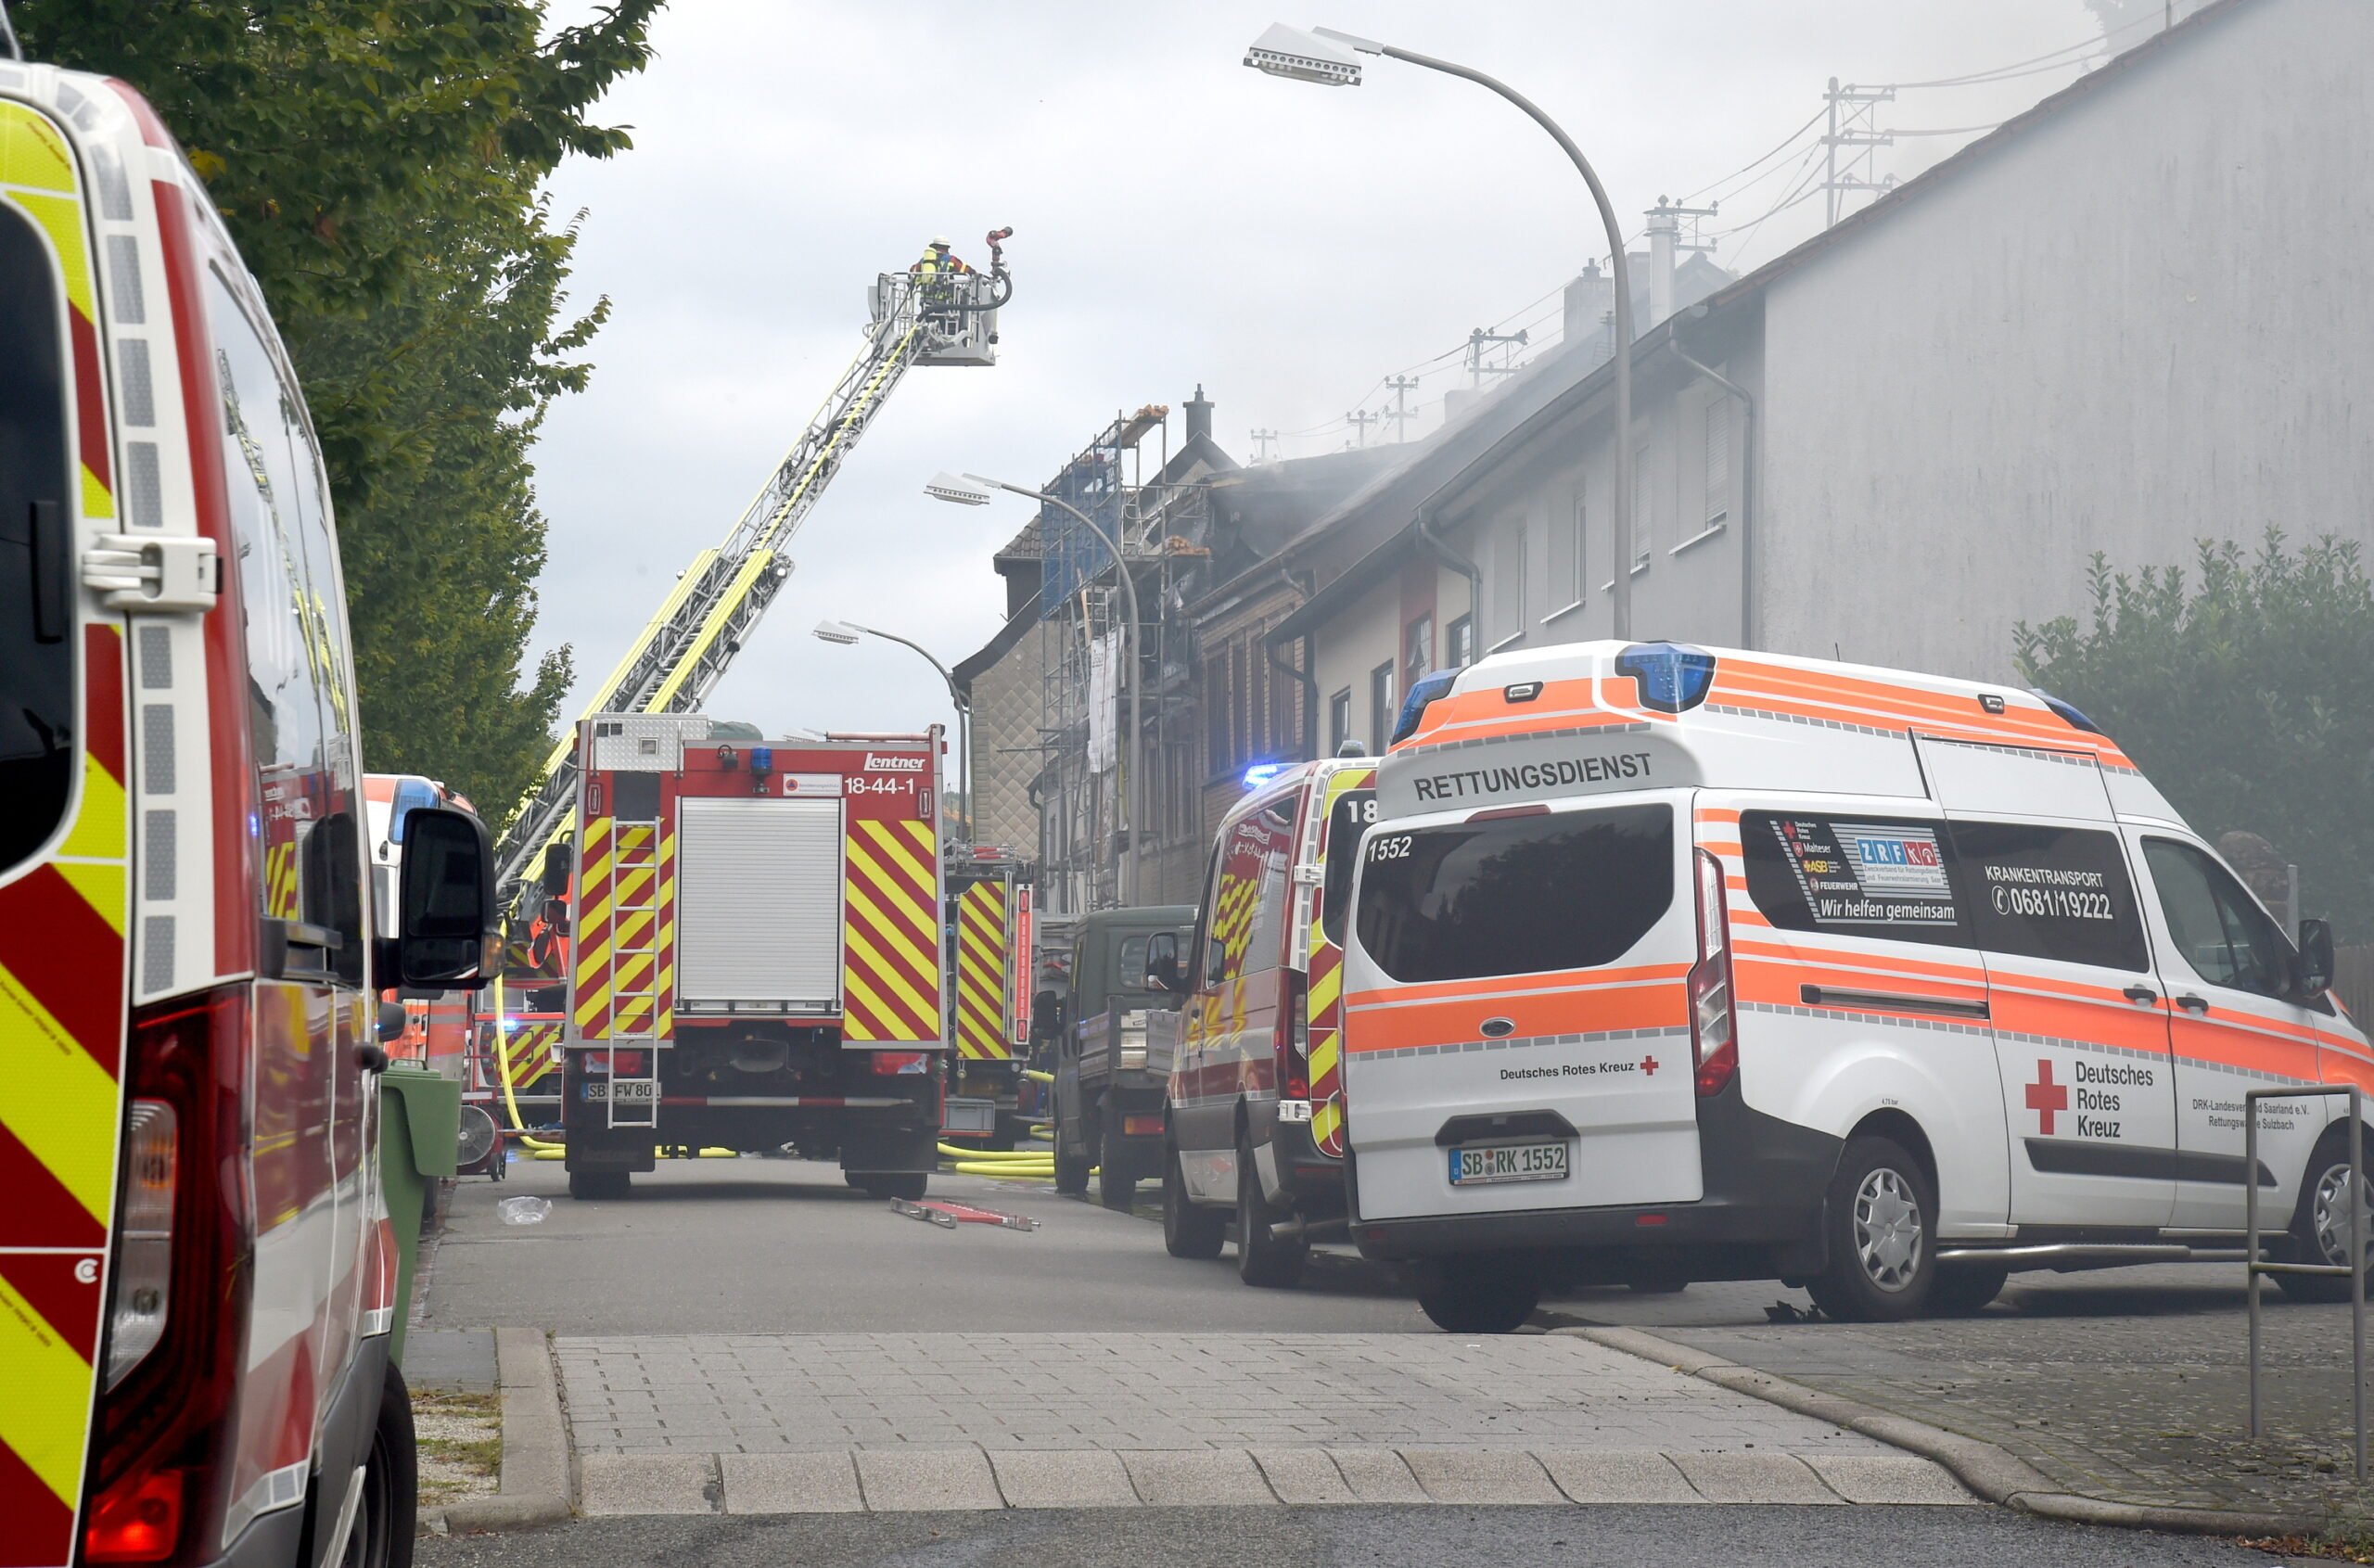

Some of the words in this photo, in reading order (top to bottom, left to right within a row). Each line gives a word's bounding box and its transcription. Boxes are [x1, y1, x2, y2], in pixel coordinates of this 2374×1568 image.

[864, 752, 925, 771] Lentner
[845, 777, 914, 795] 18-44-1
[1413, 753, 1651, 801] RETTUNGSDIENST
[1347, 799, 1378, 823] 18
[1369, 835, 1412, 863] 1552
[1803, 842, 1831, 853] Malteser
[1810, 860, 1828, 873] ASB
[1985, 865, 2103, 887] KRANKENTRANSPORT
[1819, 881, 1858, 890] FEUERWEHR
[1820, 899, 1843, 916] Wir
[1845, 899, 1884, 918] helfen
[1886, 901, 1955, 922] gemeinsam
[1500, 1067, 1559, 1080] Deutsches
[1563, 1064, 1596, 1076] Rotes
[1599, 1062, 1634, 1073] Kreuz
[2075, 1061, 2153, 1087] Deutsches
[589, 1085, 606, 1098] SB
[615, 1084, 632, 1097] FW
[636, 1084, 659, 1097] 80
[2077, 1088, 2120, 1111] Rotes
[2192, 1099, 2262, 1114] DRK-Landesvernd
[2264, 1103, 2293, 1115] Saarland
[2294, 1104, 2310, 1115] e.V.
[2077, 1115, 2121, 1138] Kreuz
[2209, 1115, 2261, 1129] Rettungswe
[2263, 1118, 2294, 1129] Sulzbach
[1461, 1153, 1484, 1176] SB
[1496, 1150, 1517, 1173] RK
[1522, 1147, 1564, 1171] 1552
